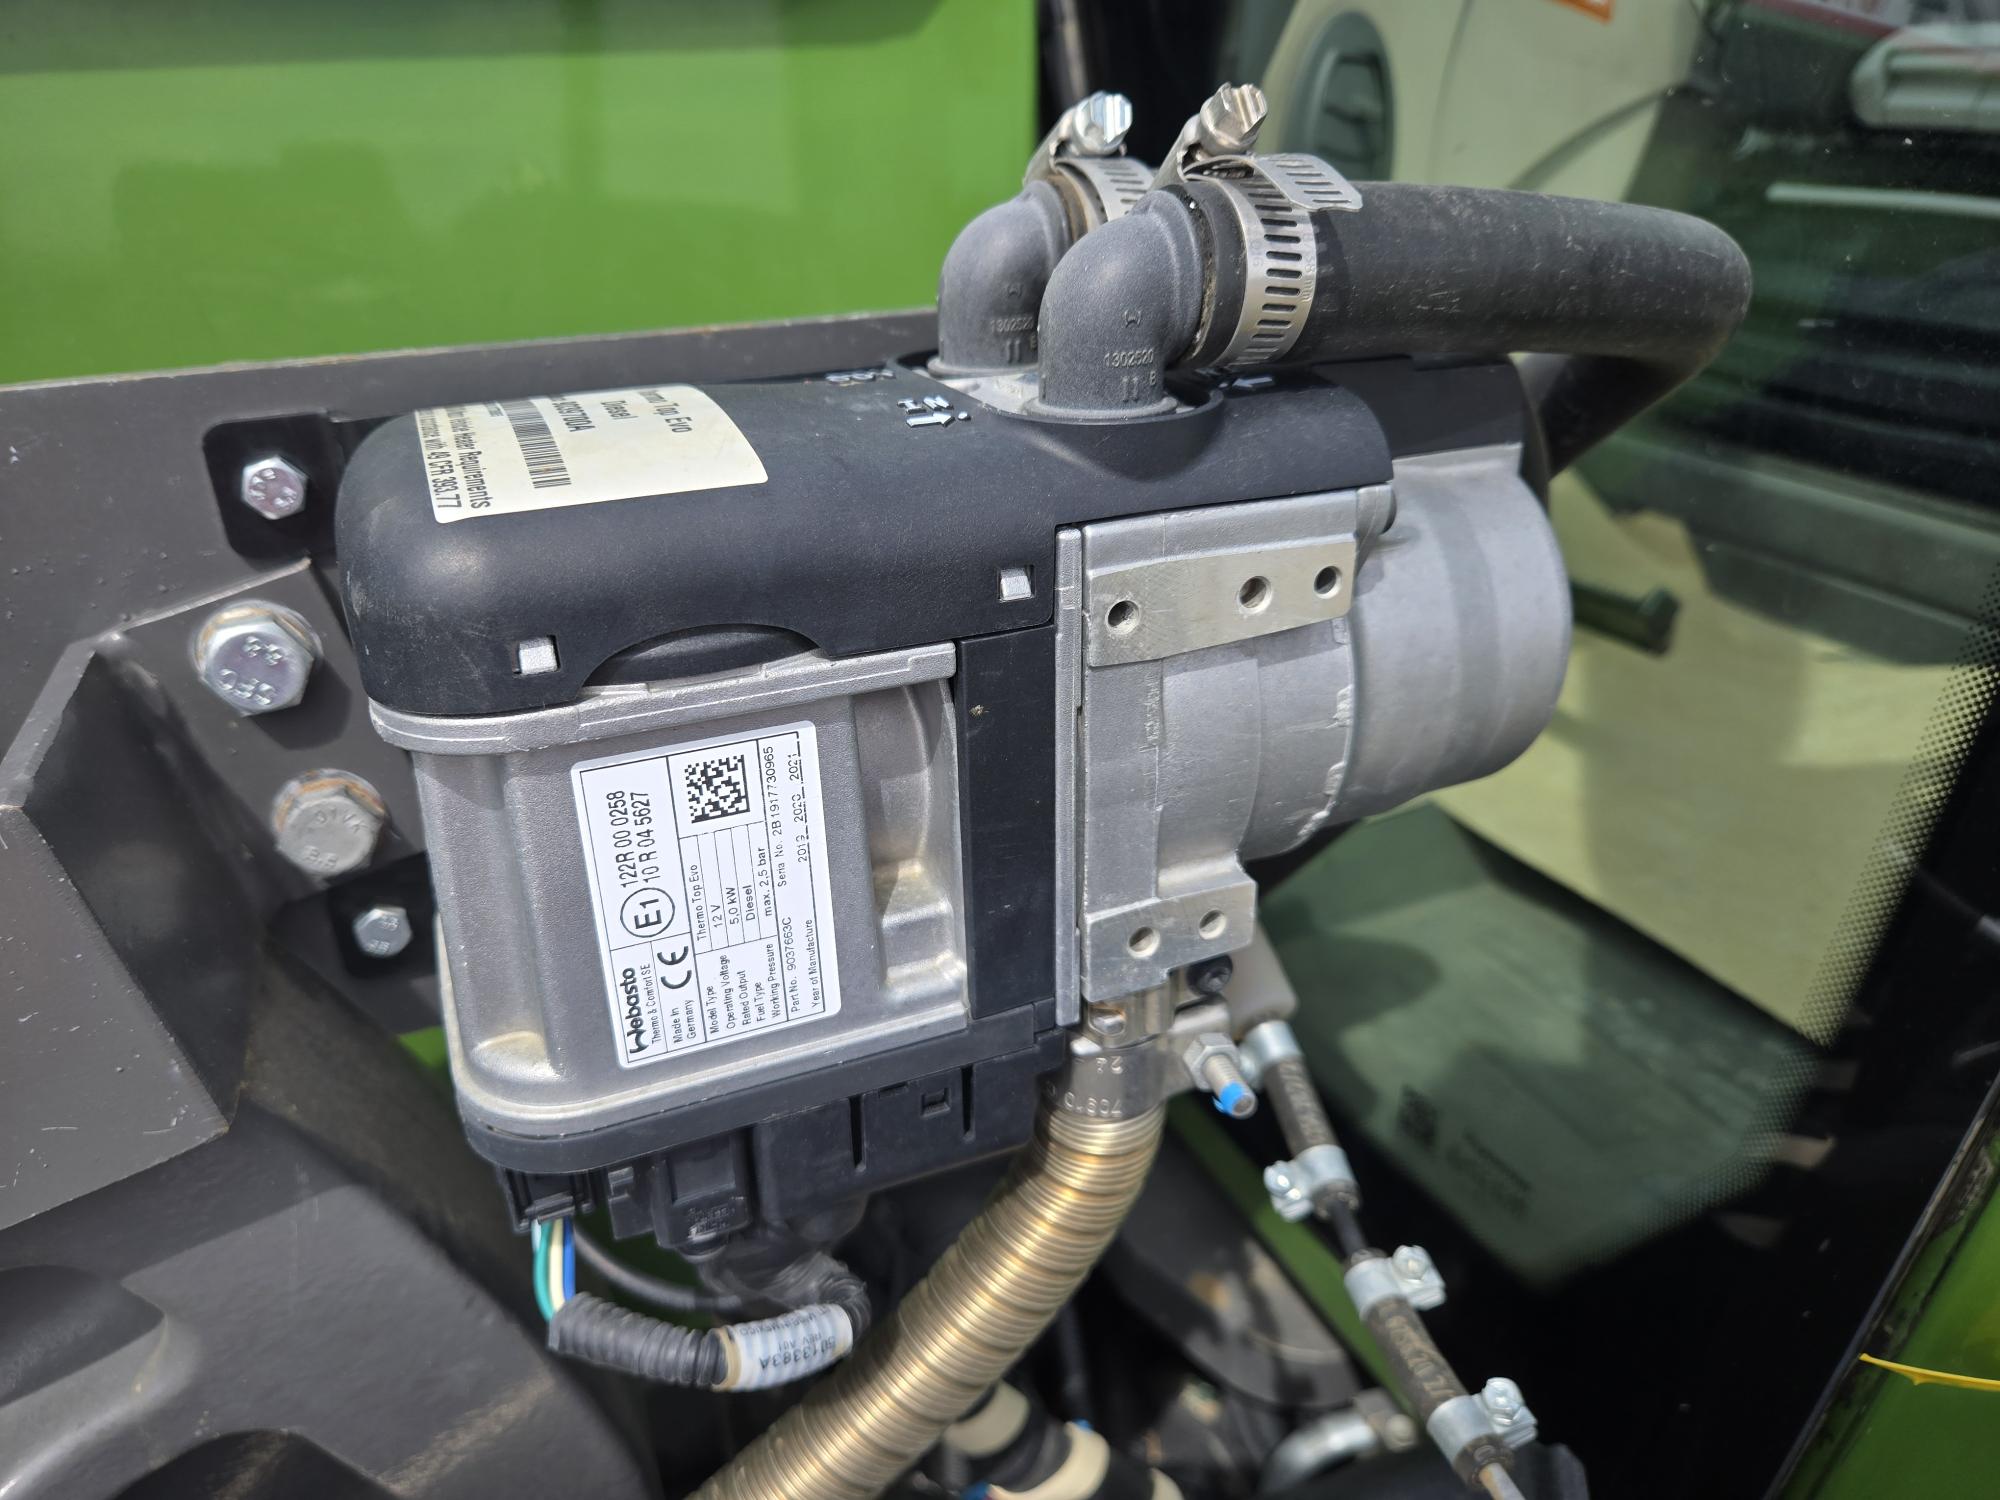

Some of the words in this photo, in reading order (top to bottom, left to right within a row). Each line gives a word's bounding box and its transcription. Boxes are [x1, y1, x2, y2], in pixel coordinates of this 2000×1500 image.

[1103, 348, 1155, 369] 1302520
[600, 400, 640, 421] Diesel
[897, 395, 954, 413] IN
[664, 416, 693, 433] Evo
[453, 432, 478, 451] Heater
[428, 460, 455, 477] CFR
[458, 450, 494, 509] Requirements
[431, 476, 463, 508] 393.77
[605, 790, 629, 827] 0258
[629, 792, 653, 826] 5627
[612, 829, 633, 849] 00
[635, 828, 656, 848] 04
[638, 850, 658, 863] R
[757, 847, 767, 867] bar
[774, 840, 784, 858] No.
[615, 850, 639, 888] 122R
[641, 865, 661, 884] 10
[688, 864, 700, 883] Evo
[757, 869, 770, 888] 2,5
[691, 884, 704, 904] Top
[725, 887, 737, 905] kW
[742, 884, 756, 922] Diesel
[762, 889, 773, 917] max.
[710, 904, 721, 913] V
[727, 907, 740, 925] 5,0
[695, 904, 707, 942] Thermo
[711, 914, 723, 929] 12
[781, 916, 797, 971] 9037663C
[805, 919, 818, 976] Manufacture
[639, 963, 651, 976] SE
[719, 954, 731, 988] Voltage
[765, 943, 777, 982] Pressure
[642, 975, 657, 1007] Comfort
[736, 969, 749, 1000] Output
[788, 976, 799, 993] No.
[808, 976, 819, 986] of
[705, 985, 718, 1007] Type
[753, 981, 766, 1003] Type
[769, 982, 781, 1019] Working
[811, 987, 821, 1008] Year
[619, 967, 649, 1055] Webasto
[723, 987, 737, 1030] Operating
[739, 1000, 752, 1026] Rated
[754, 1002, 766, 1022] Fuel
[789, 993, 801, 1013] Part
[650, 1015, 662, 1045] Thermo
[684, 999, 697, 1040] Germany
[706, 1007, 720, 1035] Model
[671, 1017, 684, 1044] Made
